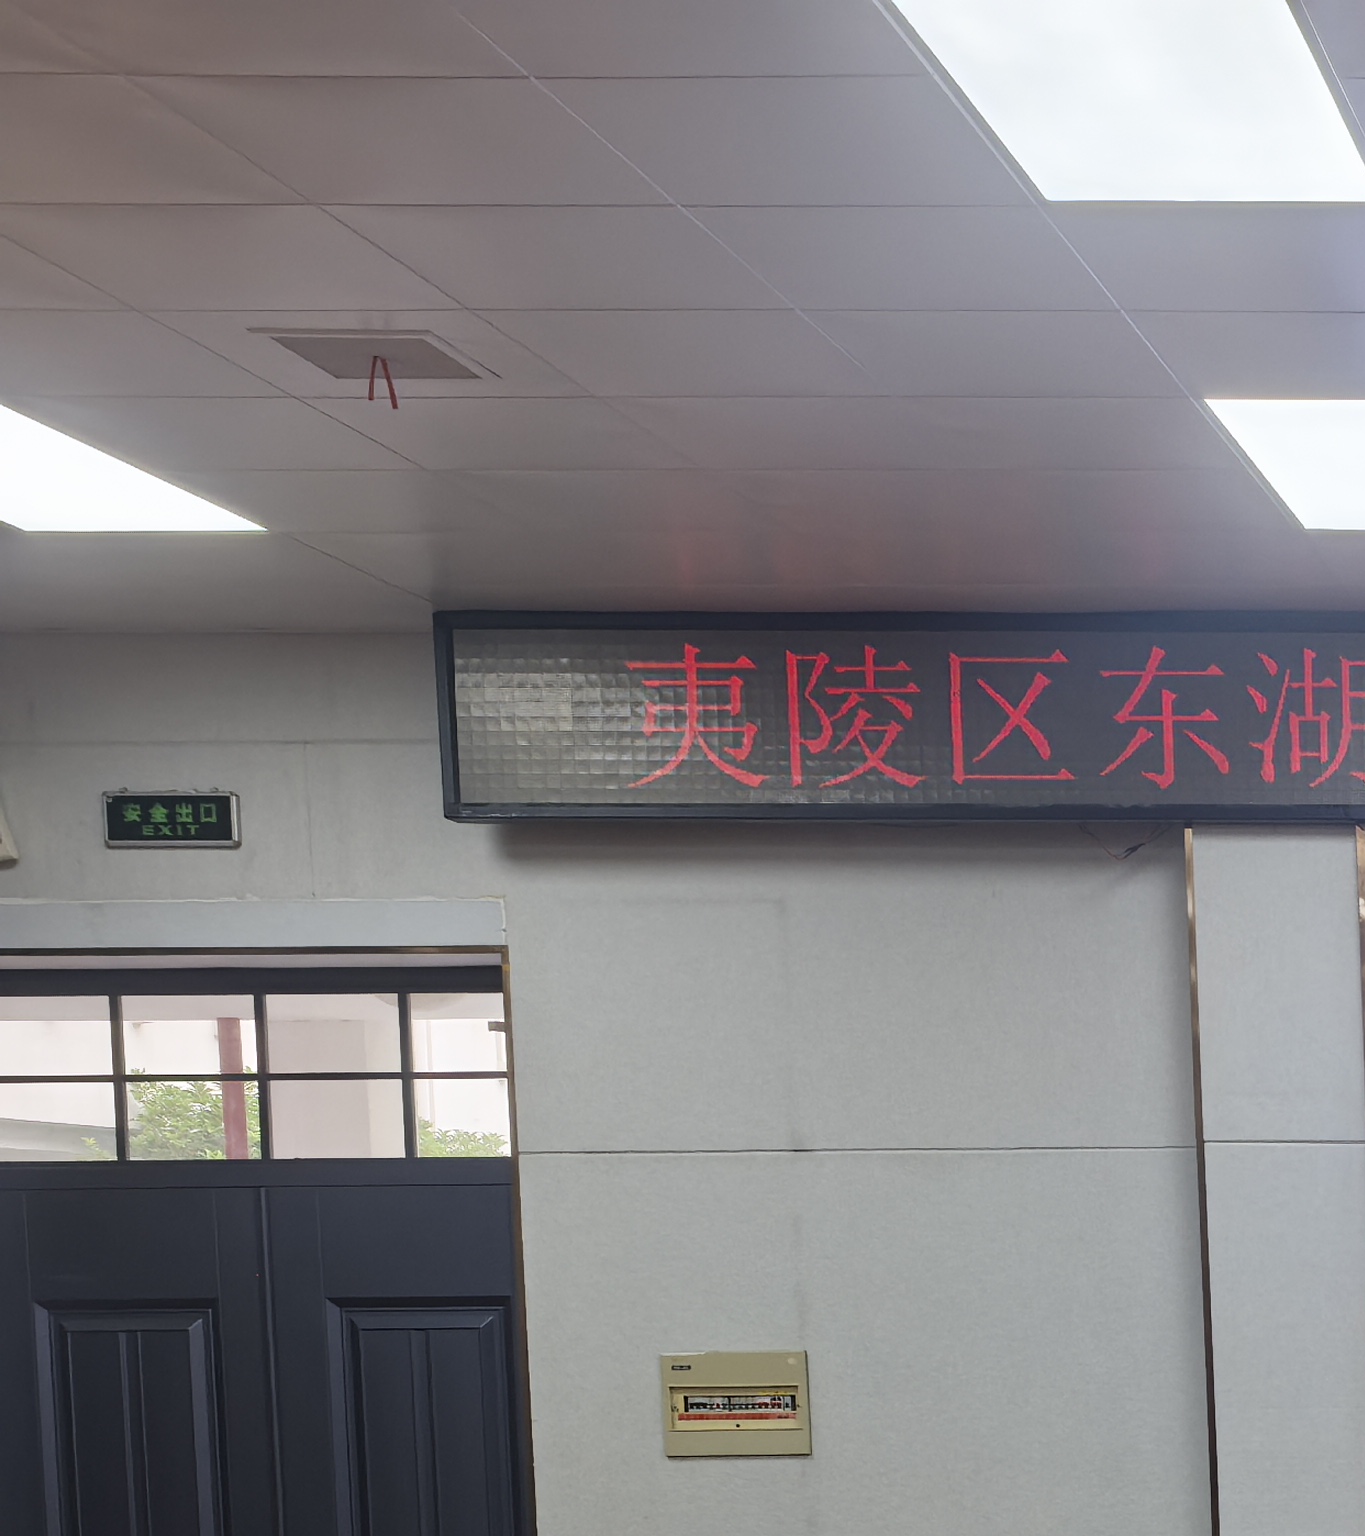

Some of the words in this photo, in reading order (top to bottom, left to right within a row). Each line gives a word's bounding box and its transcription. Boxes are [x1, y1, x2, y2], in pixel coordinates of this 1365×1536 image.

[122, 803, 218, 823] 安全出口
[142, 825, 200, 836] EXIT
